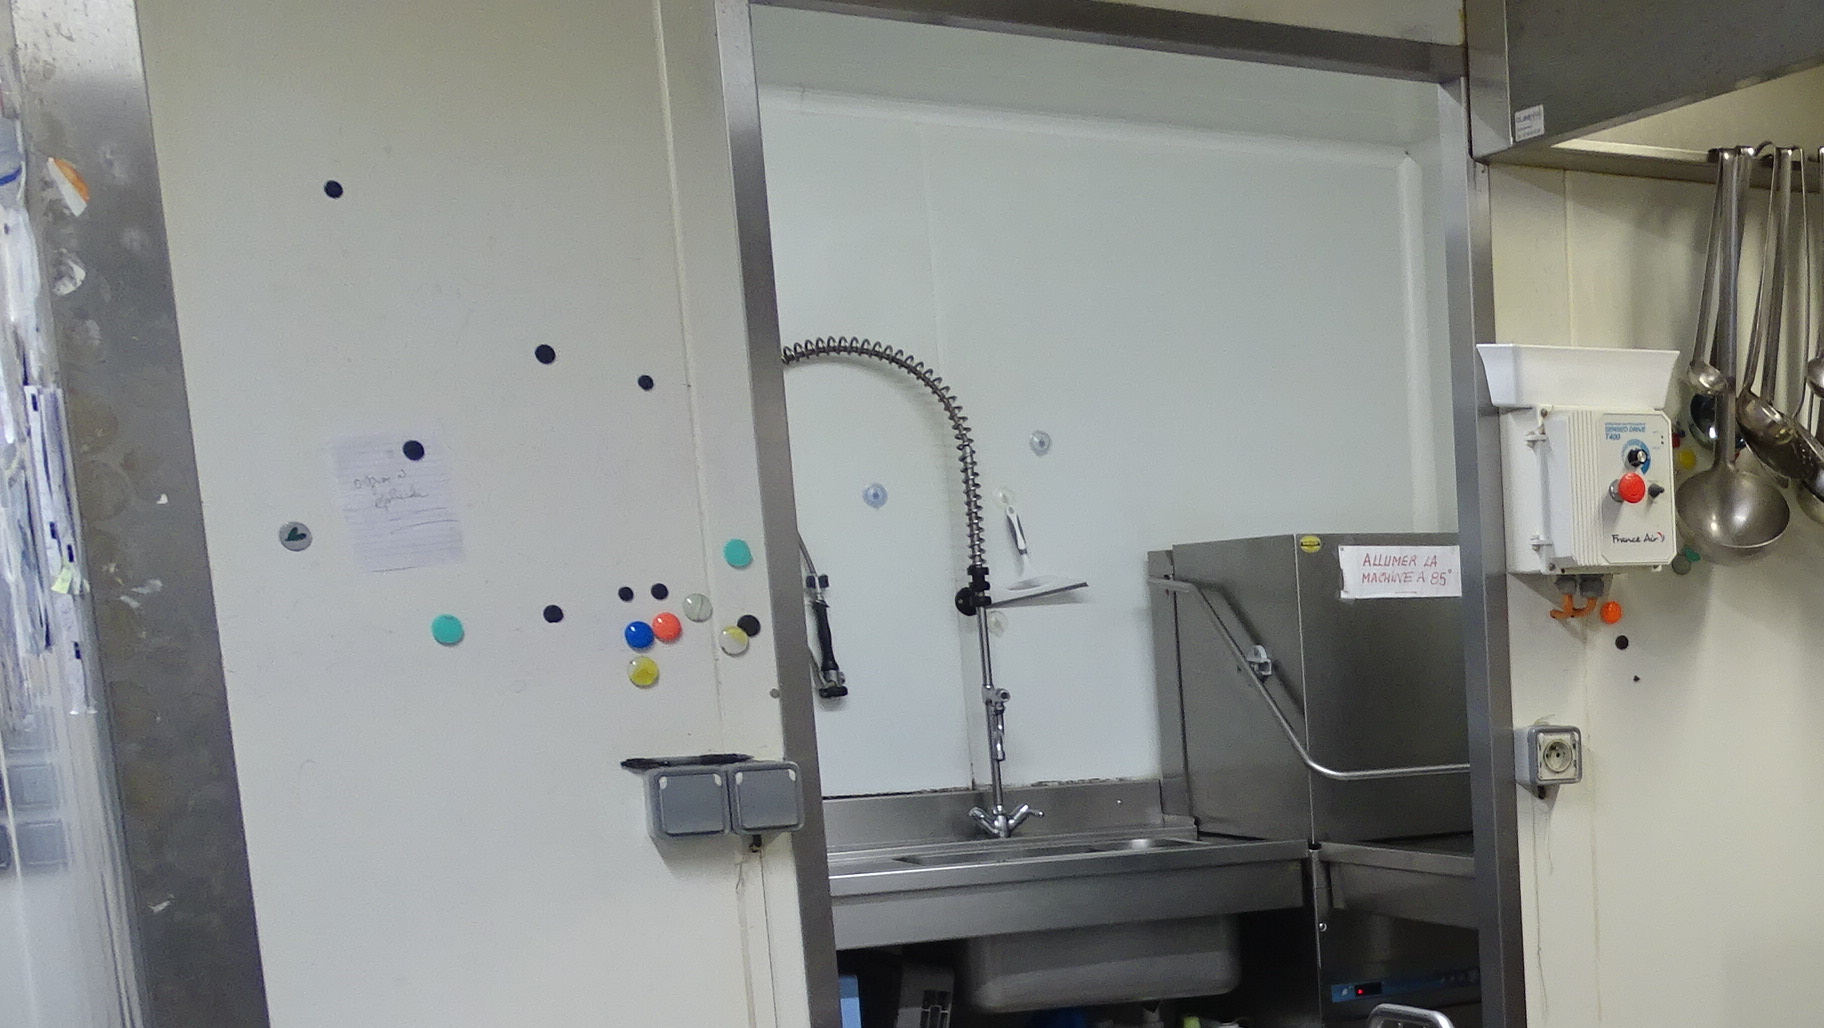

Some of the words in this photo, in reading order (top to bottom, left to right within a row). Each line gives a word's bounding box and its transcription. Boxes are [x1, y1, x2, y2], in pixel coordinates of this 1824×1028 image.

[1612, 533, 1640, 544] France
[1643, 532, 1658, 543] Air
[1363, 553, 1417, 567] ALLUMER
[1423, 555, 1438, 568] LA
